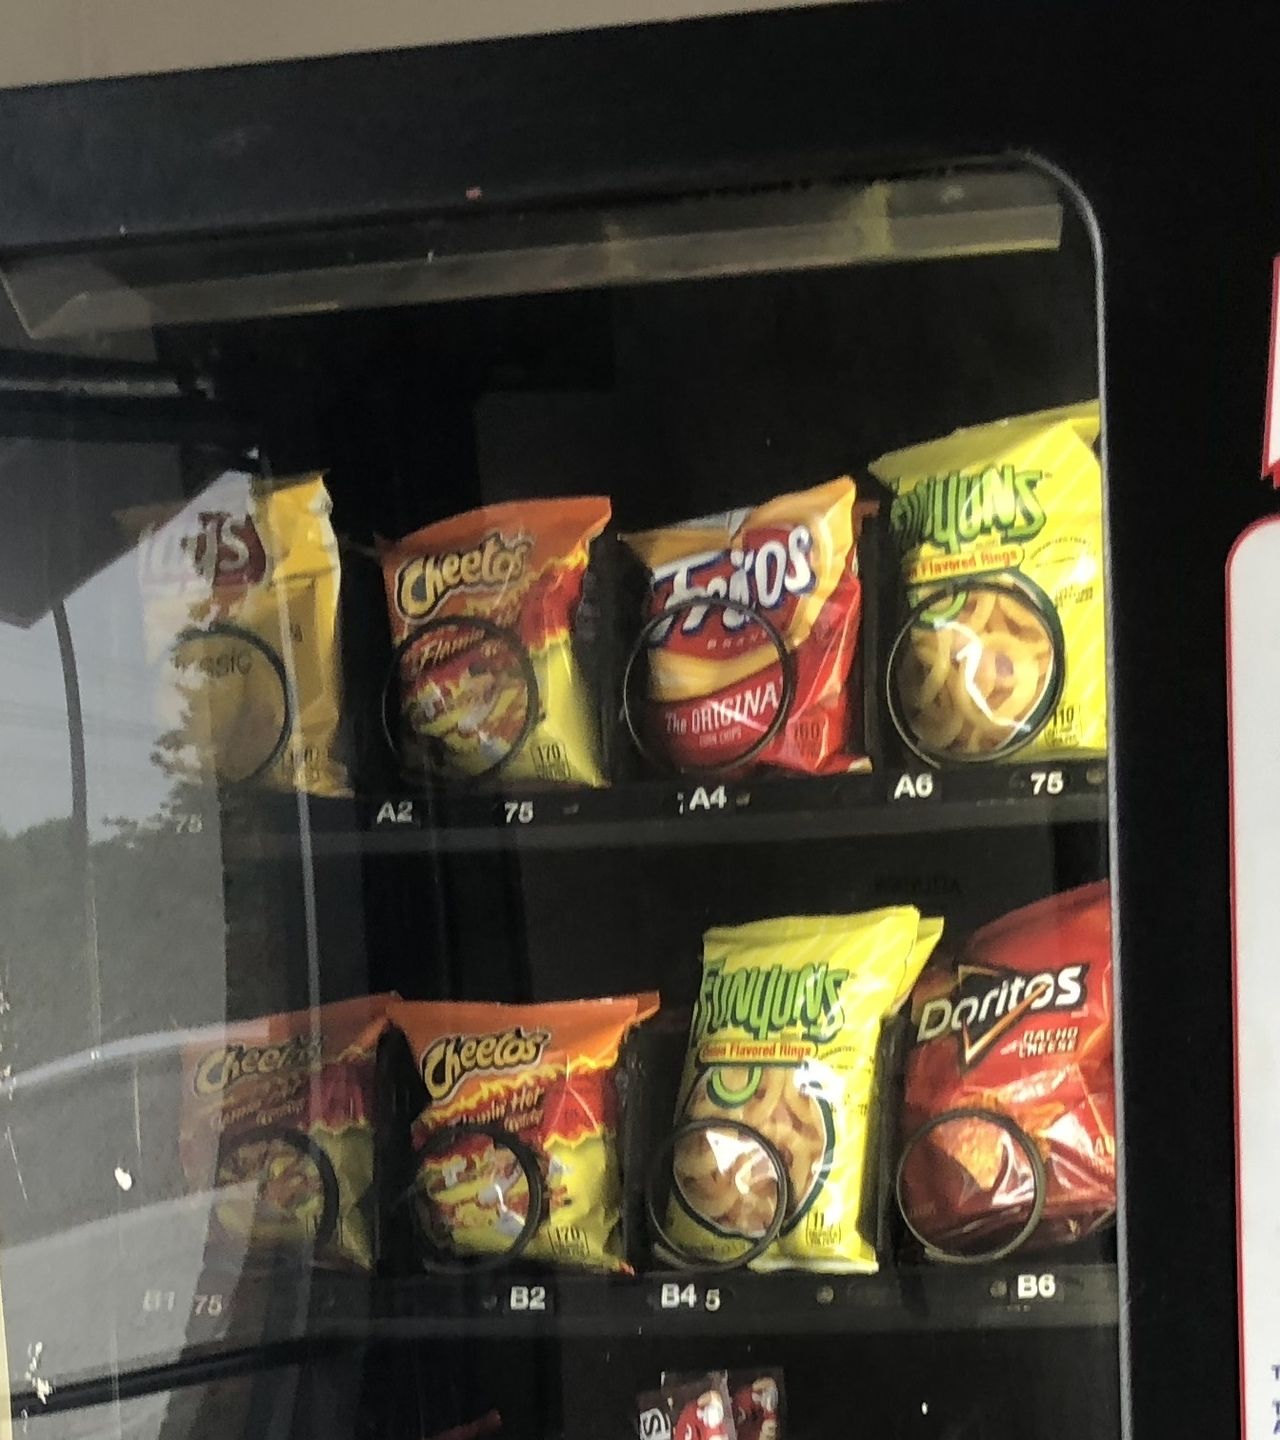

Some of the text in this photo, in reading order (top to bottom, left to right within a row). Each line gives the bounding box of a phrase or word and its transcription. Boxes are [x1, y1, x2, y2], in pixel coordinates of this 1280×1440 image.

[401, 539, 532, 619] Cheetos
[665, 677, 784, 734] The ORIGINA
[689, 784, 727, 810] A4
[894, 771, 1064, 799] A6 75
[376, 801, 534, 824] A2 75
[917, 965, 1083, 1042] Doritos
[730, 1043, 776, 1057] Flavored
[425, 1031, 550, 1099] Cheetos
[510, 1286, 546, 1311] B2
[661, 1283, 696, 1308] B4
[1017, 1274, 1056, 1299] B6
